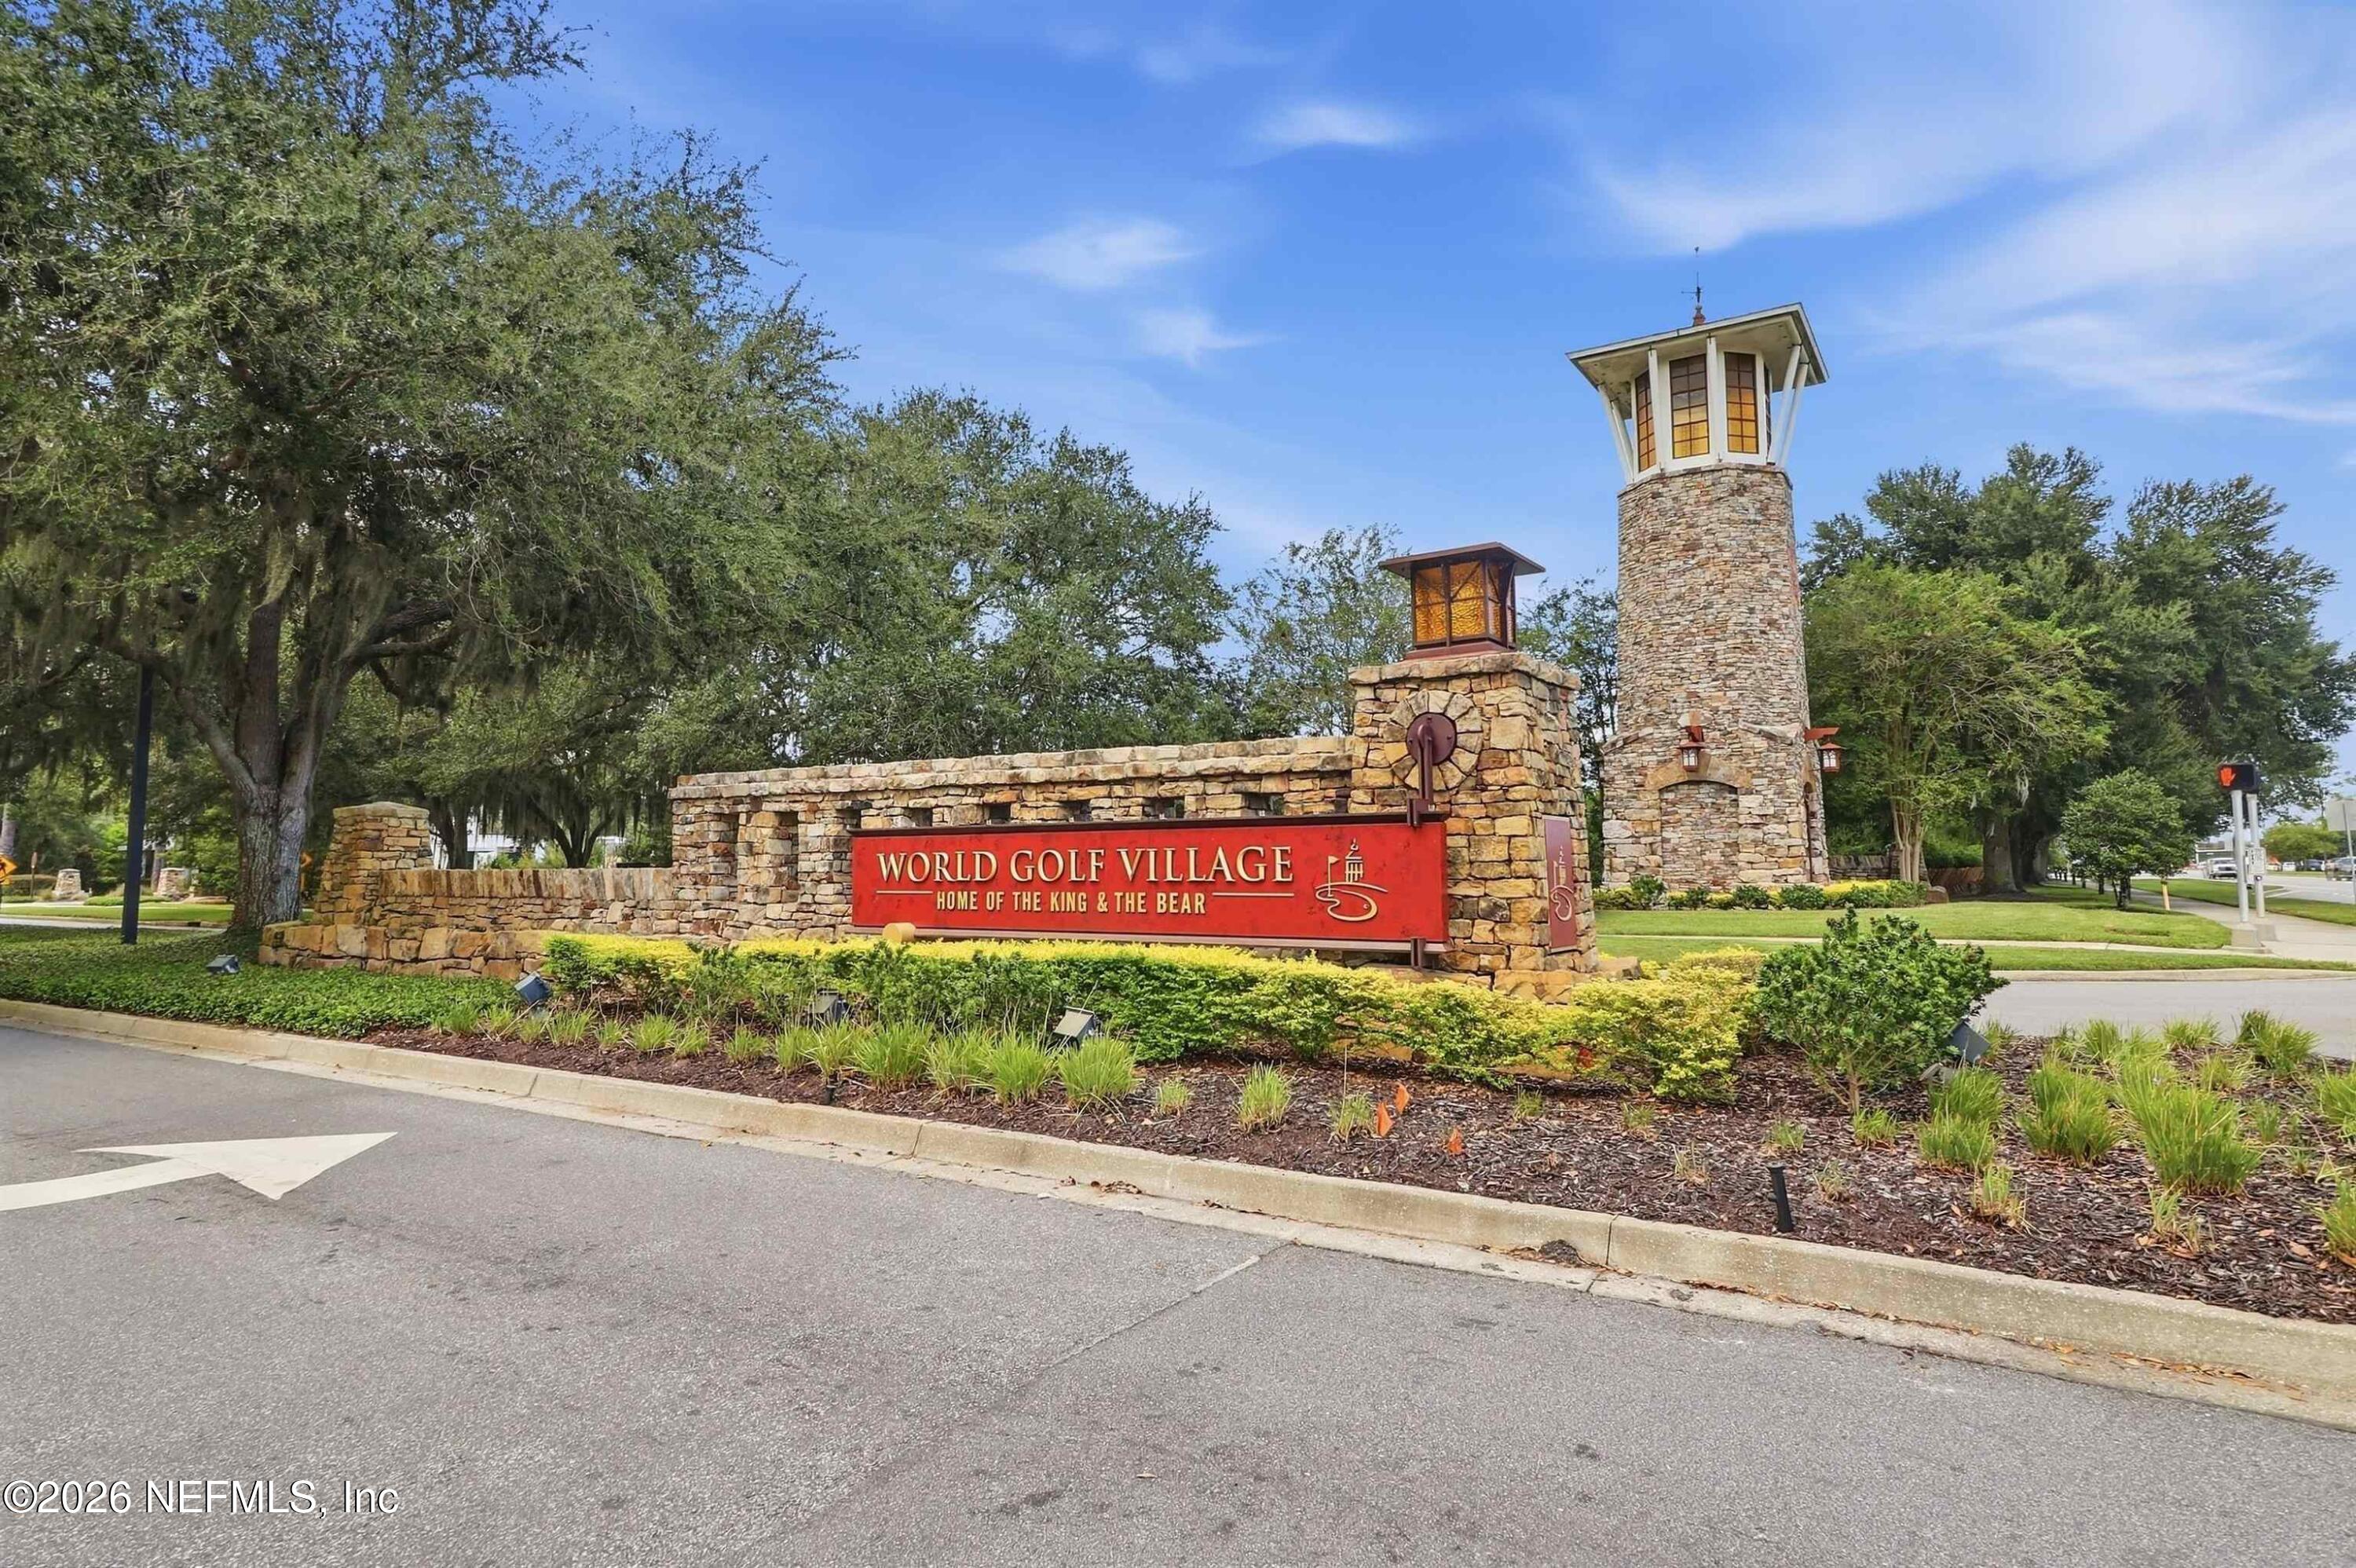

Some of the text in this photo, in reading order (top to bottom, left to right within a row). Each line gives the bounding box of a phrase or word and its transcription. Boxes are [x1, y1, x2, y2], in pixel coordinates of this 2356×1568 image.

[876, 846, 1293, 883] WORLD GOLF VILLAGE
[937, 891, 1206, 914] HOME OF THE KING & THE BEAR
